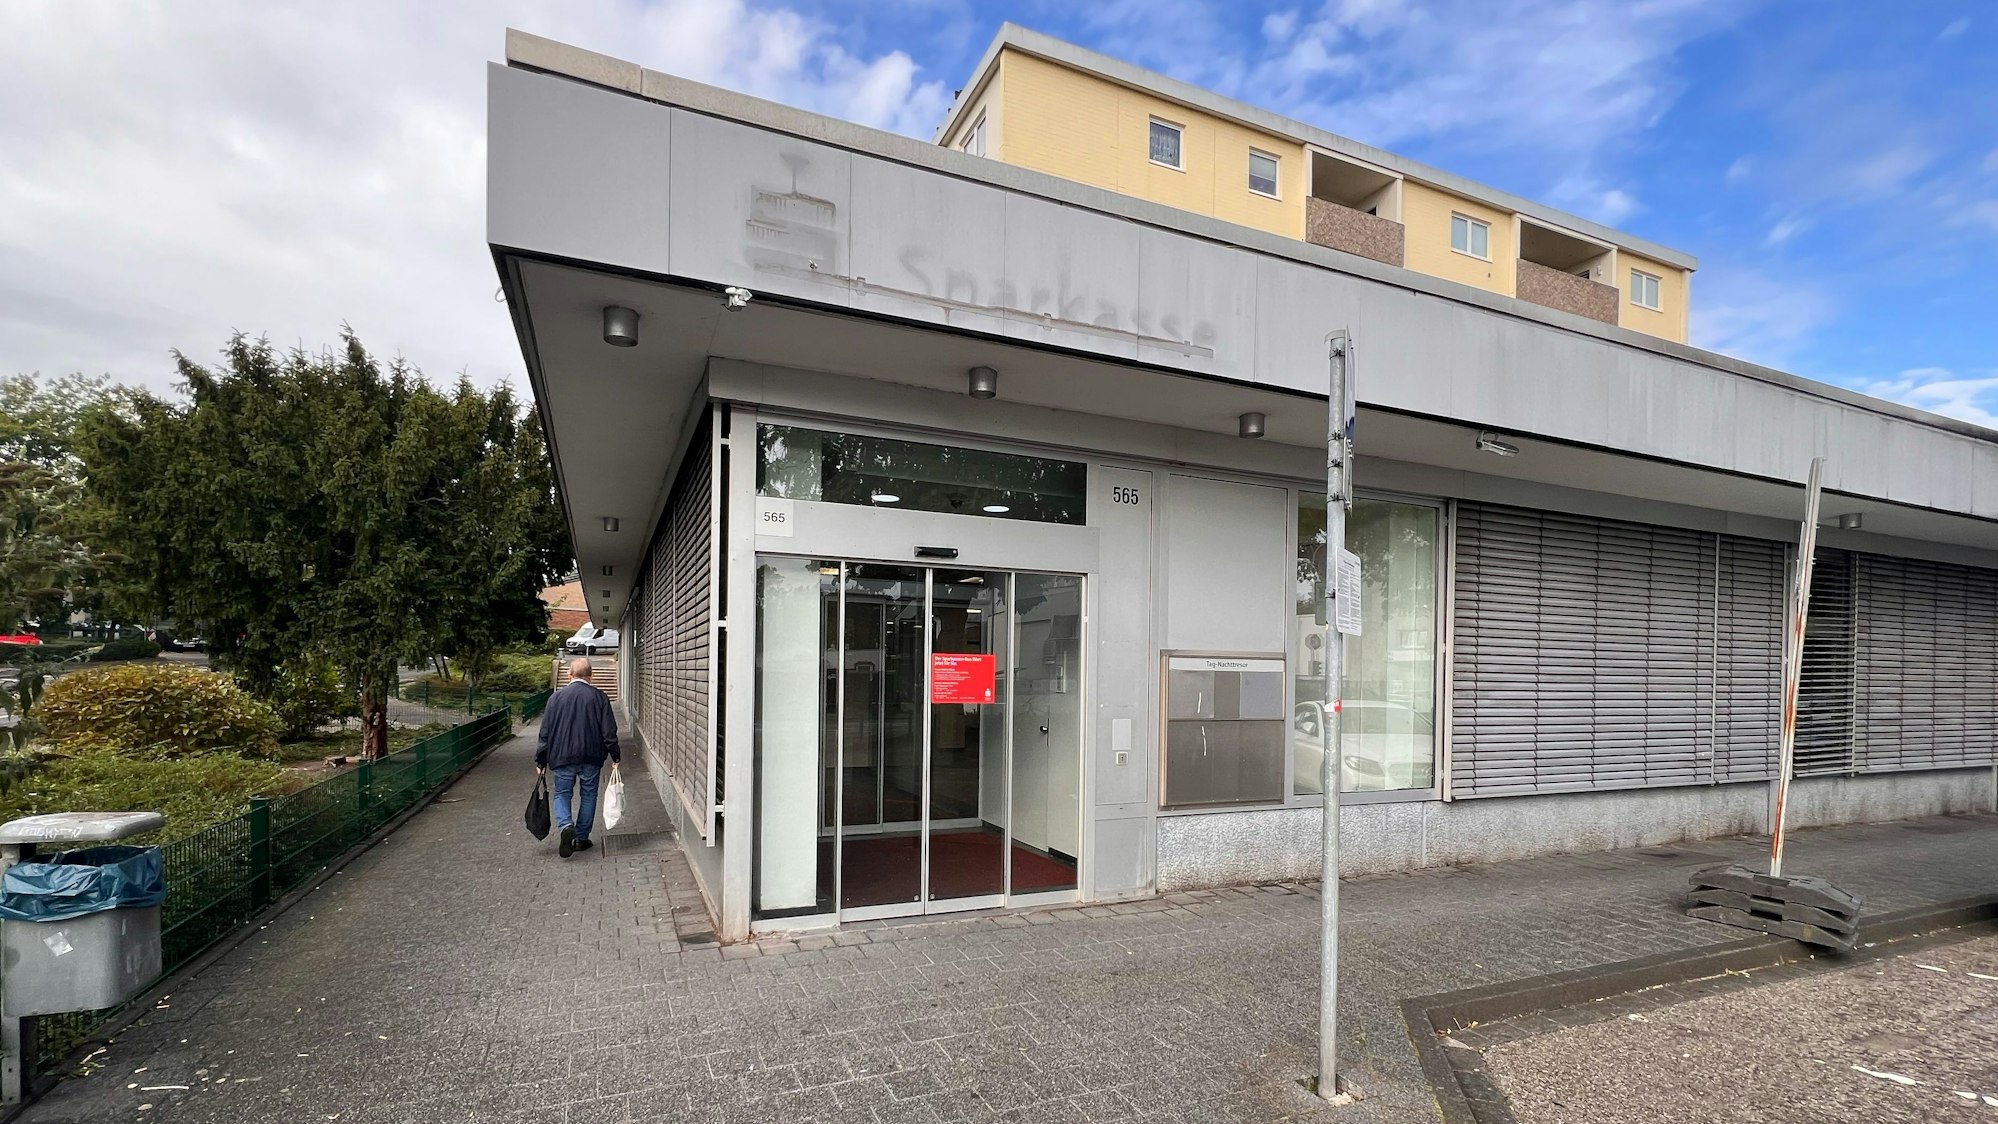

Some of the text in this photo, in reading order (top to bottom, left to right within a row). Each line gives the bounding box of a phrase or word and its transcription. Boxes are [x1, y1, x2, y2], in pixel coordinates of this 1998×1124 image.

[898, 244, 1219, 346] Sparkasse
[1113, 486, 1139, 505] 565
[763, 511, 786, 523] 565
[1206, 661, 1248, 669] Tag-Nachttresor
